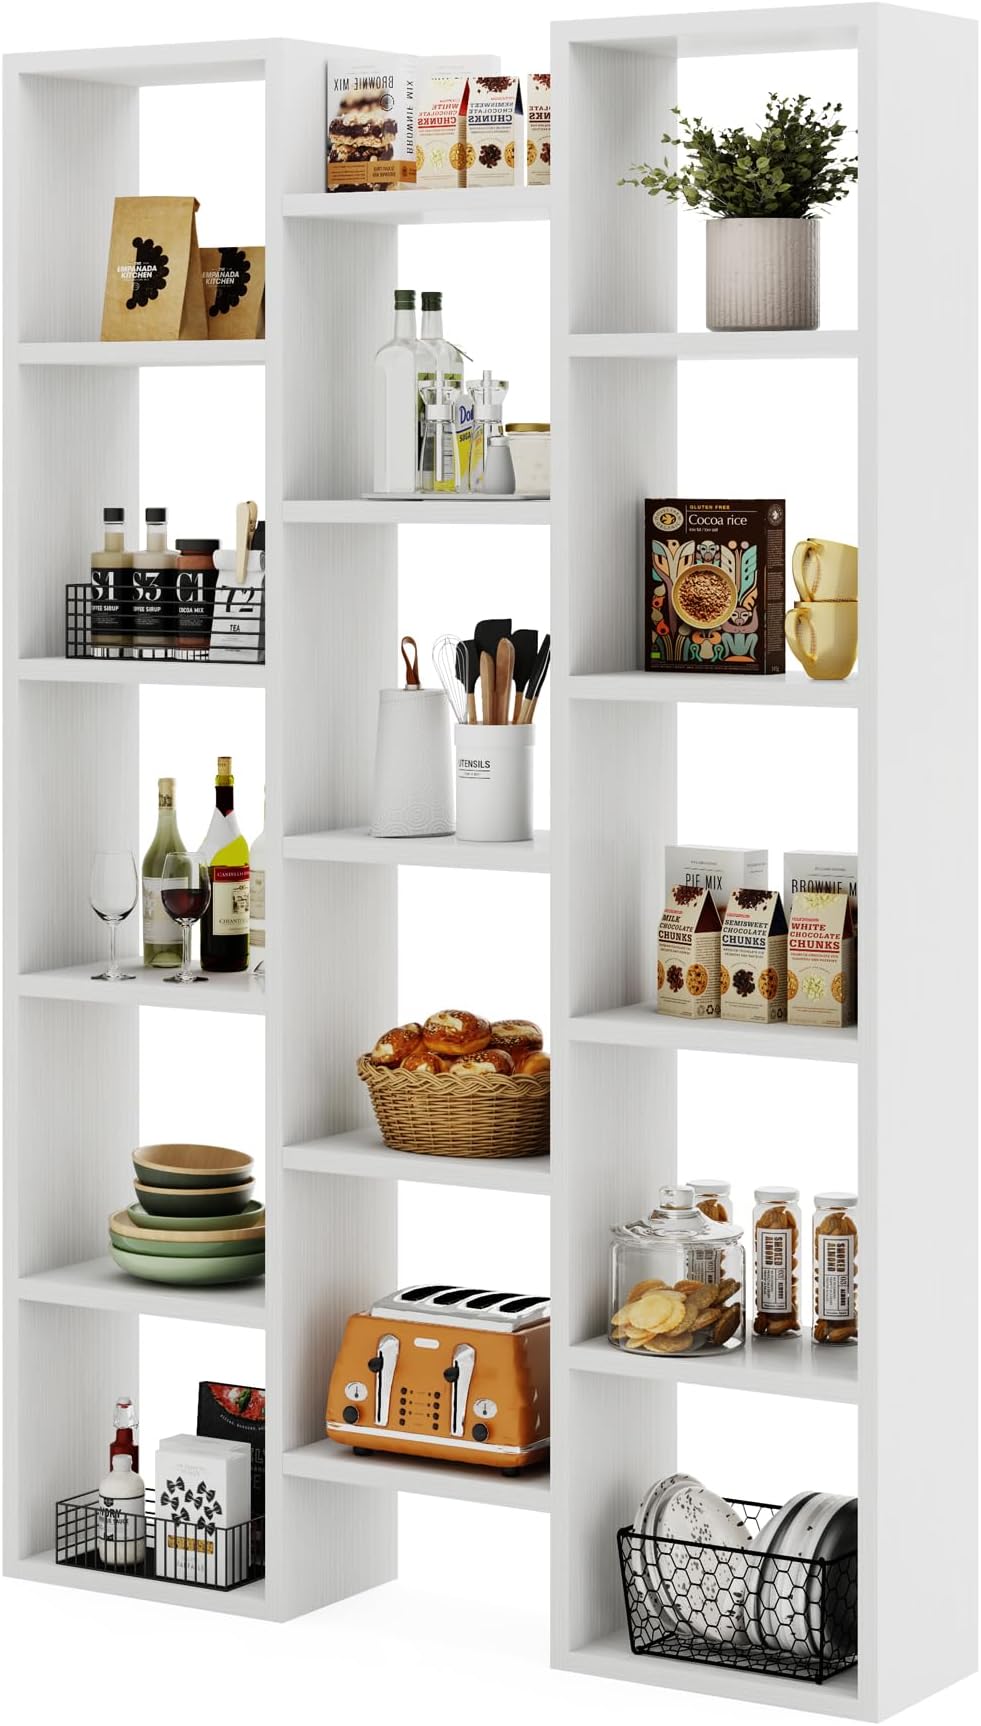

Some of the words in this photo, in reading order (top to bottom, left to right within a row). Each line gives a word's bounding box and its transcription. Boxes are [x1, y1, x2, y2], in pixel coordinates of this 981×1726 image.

[117, 264, 158, 273] EMPANADA
[202, 270, 240, 278] EMPANADA
[120, 271, 153, 279] KITCHEN
[205, 277, 235, 285] KITCHEN
[688, 514, 724, 526] Cocoa
[727, 514, 748, 526] rice
[132, 571, 162, 601] S3
[176, 572, 206, 602] C1
[229, 624, 241, 632] TEA
[705, 874, 723, 891] MIX
[791, 878, 843, 895] BROWNIE
[661, 914, 681, 923] MILK
[724, 919, 769, 929] SEMISWEET
[659, 922, 695, 932] CHOCOLATE
[722, 926, 767, 936] CHOCOLATE
[791, 922, 827, 931] WHITE
[658, 930, 693, 942] CHUNKS
[722, 934, 766, 946] CHUNKS
[789, 931, 841, 940] CHOCOLATE
[789, 938, 840, 950] CHUNKS
[764, 1235, 774, 1266] ALMOND
[773, 1236, 783, 1266] SMOKED
[826, 1242, 836, 1272] ALMOND
[836, 1242, 846, 1272] SMOKED
